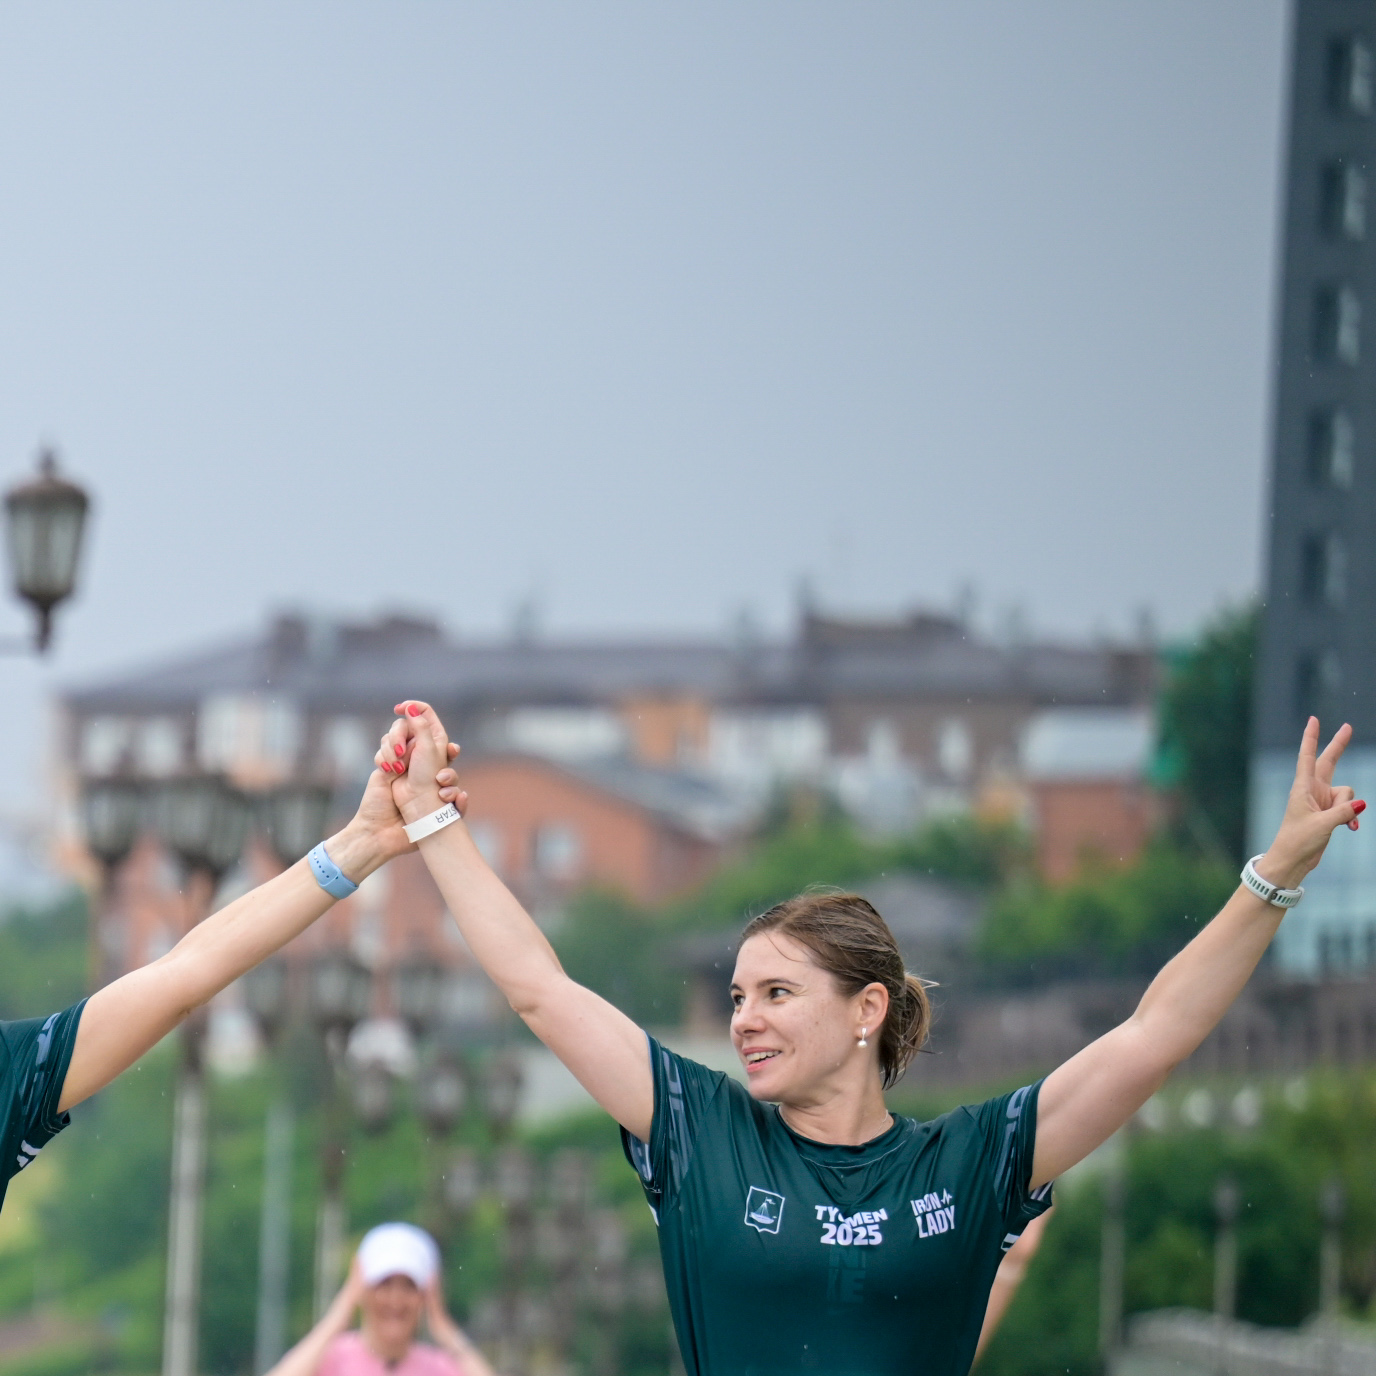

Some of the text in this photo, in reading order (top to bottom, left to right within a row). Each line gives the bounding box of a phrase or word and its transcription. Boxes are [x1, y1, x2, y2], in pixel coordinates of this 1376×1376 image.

[910, 1191, 943, 1217] IRON
[820, 1222, 883, 1246] 2025
[916, 1204, 956, 1238] LADY
